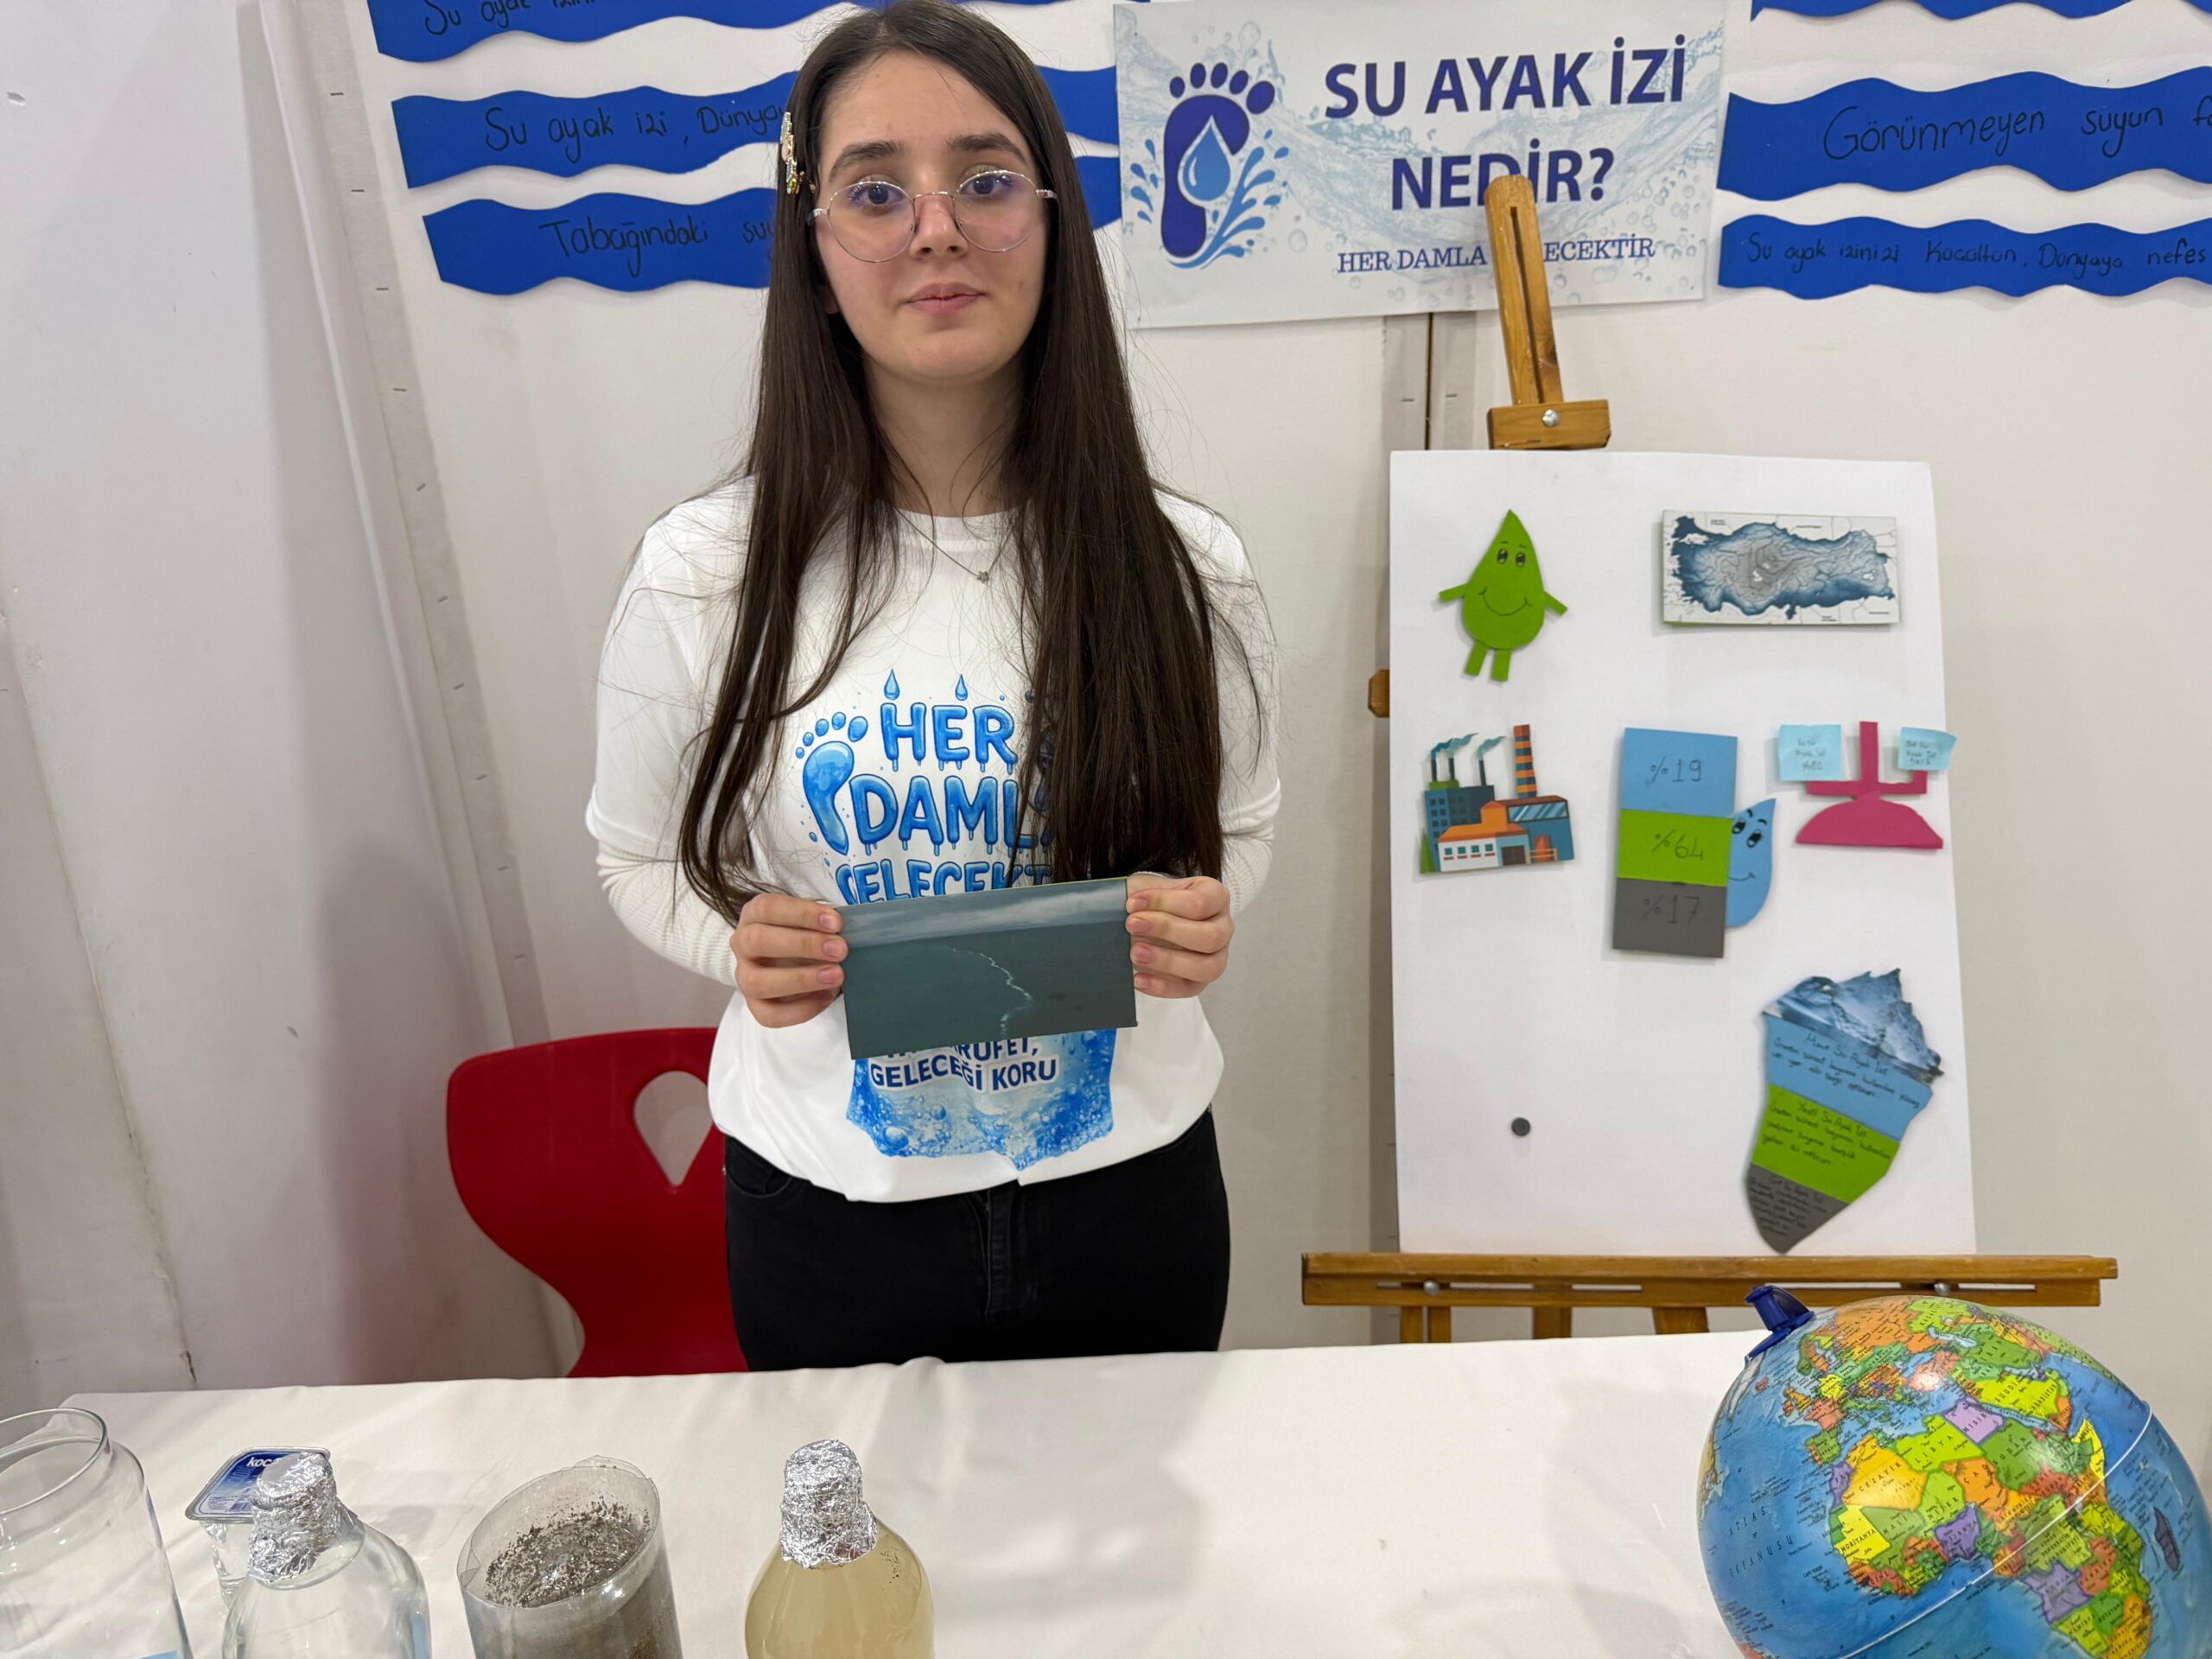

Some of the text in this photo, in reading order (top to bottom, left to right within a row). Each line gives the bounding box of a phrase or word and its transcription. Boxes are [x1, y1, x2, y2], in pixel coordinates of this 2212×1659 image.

[1324, 34, 1687, 118] SU AYAK İZİ
[485, 106, 527, 151] Su
[548, 107, 614, 164] ayak
[1823, 105, 2045, 160] Görünmeyen
[1337, 233, 1656, 273] HER DAMLA ECEKTİR
[1748, 232, 1772, 263] Su
[1784, 238, 1827, 274] ayak
[2147, 238, 2206, 264] nefes
[880, 702, 1019, 770] HER
[1649, 757, 1702, 784] %19
[849, 773, 1042, 852] DAML
[1654, 829, 1704, 861] %64
[1643, 893, 1701, 925] %17
[869, 1054, 1057, 1091] GELECEĞİ KORU
[246, 1456, 281, 1467] koc
[1840, 1529, 1877, 1552] MORİTANYA
